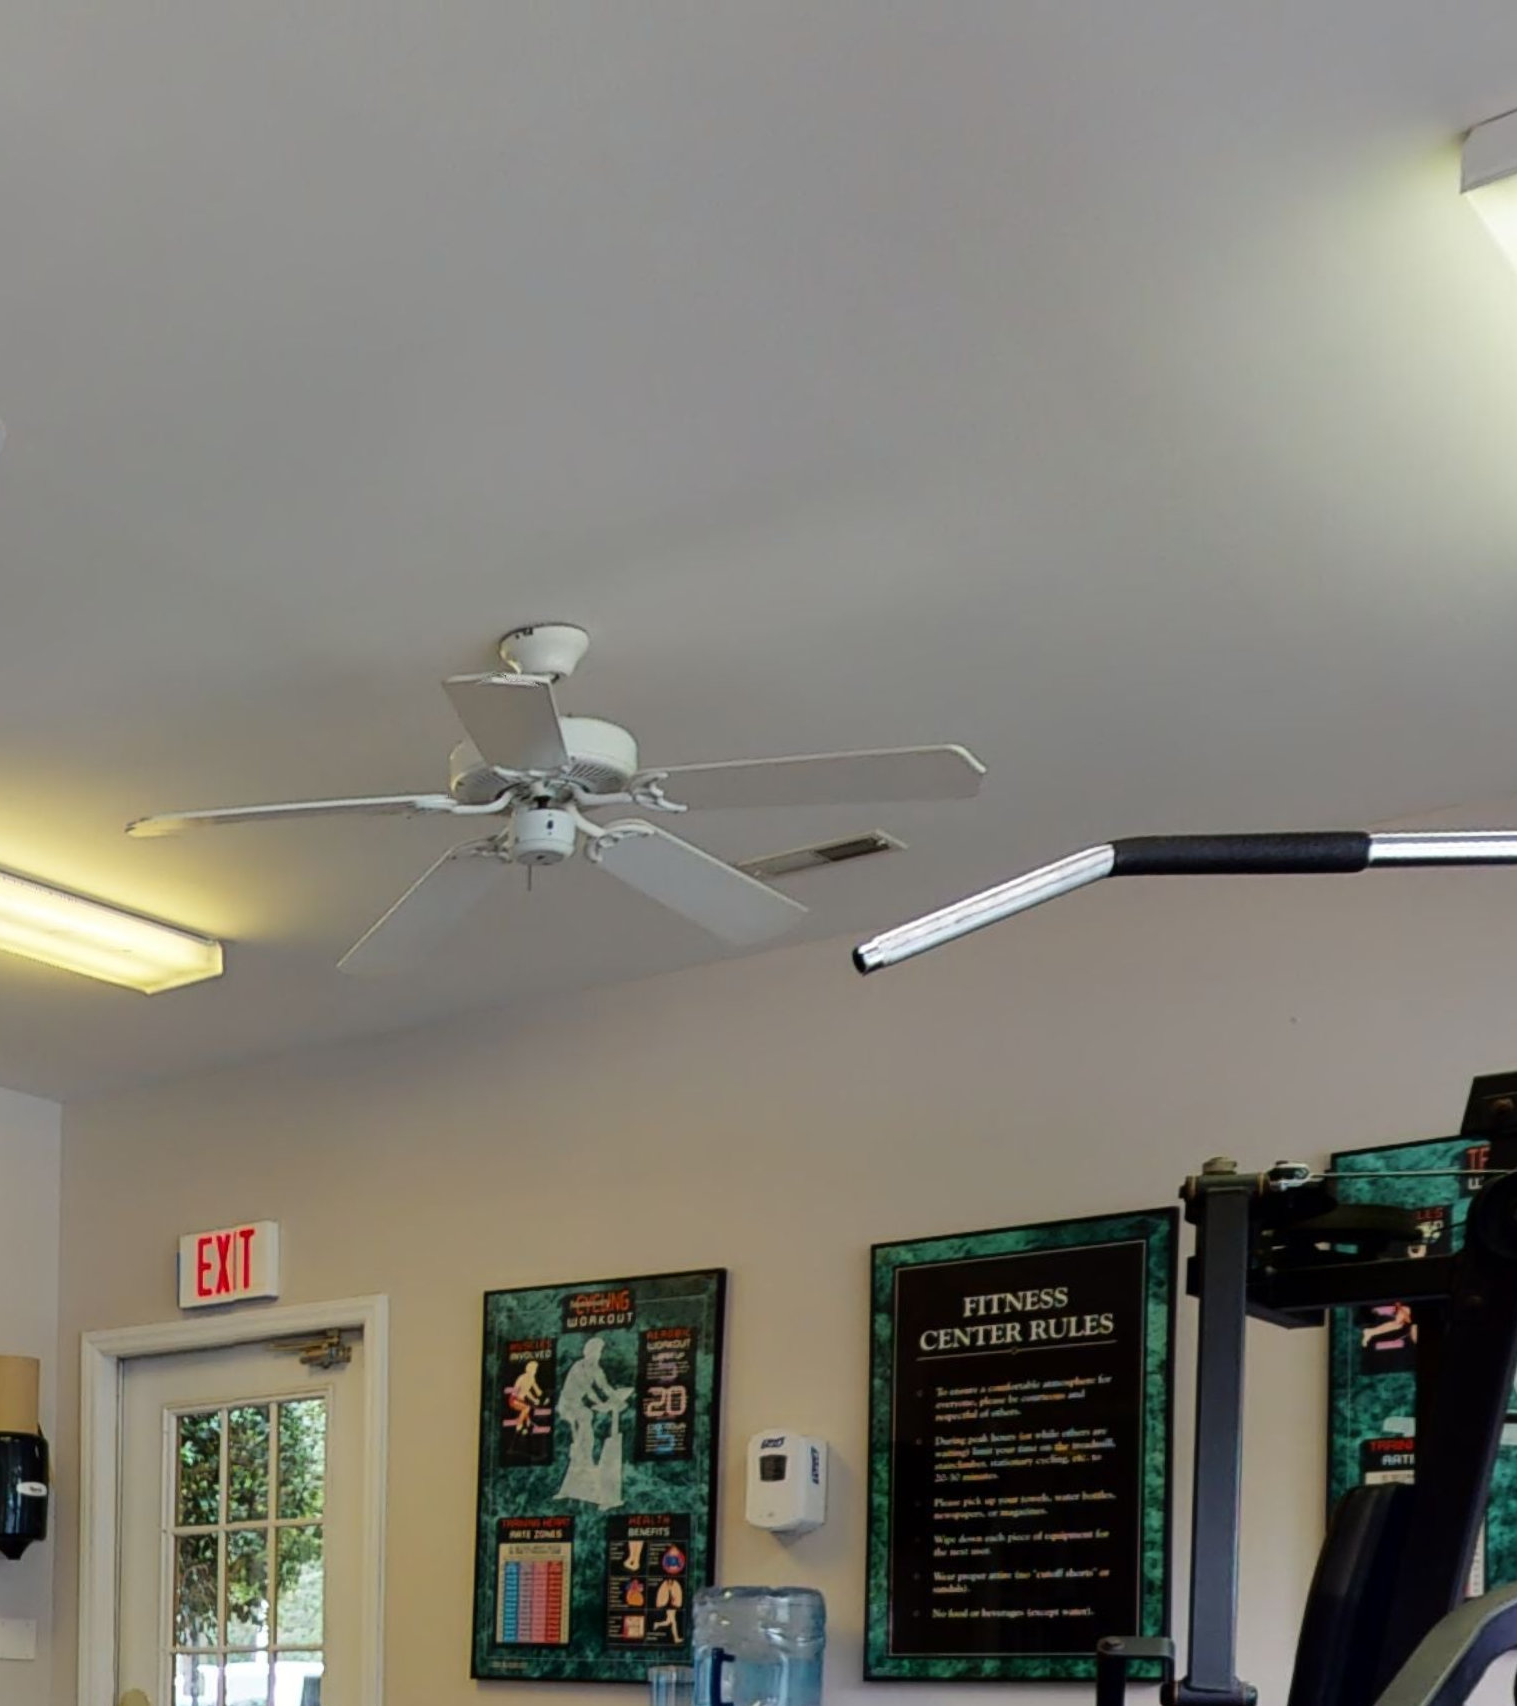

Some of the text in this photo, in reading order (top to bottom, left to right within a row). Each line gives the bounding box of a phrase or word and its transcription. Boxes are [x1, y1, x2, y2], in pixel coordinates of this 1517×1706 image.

[196, 1228, 256, 1298] EXIT
[963, 1286, 1069, 1318] FITNESS
[565, 1311, 635, 1329] WORKOUT
[919, 1312, 1115, 1351] CENTER RULES
[644, 1385, 687, 1418] 20
[627, 1527, 671, 1538] BENEFITS
